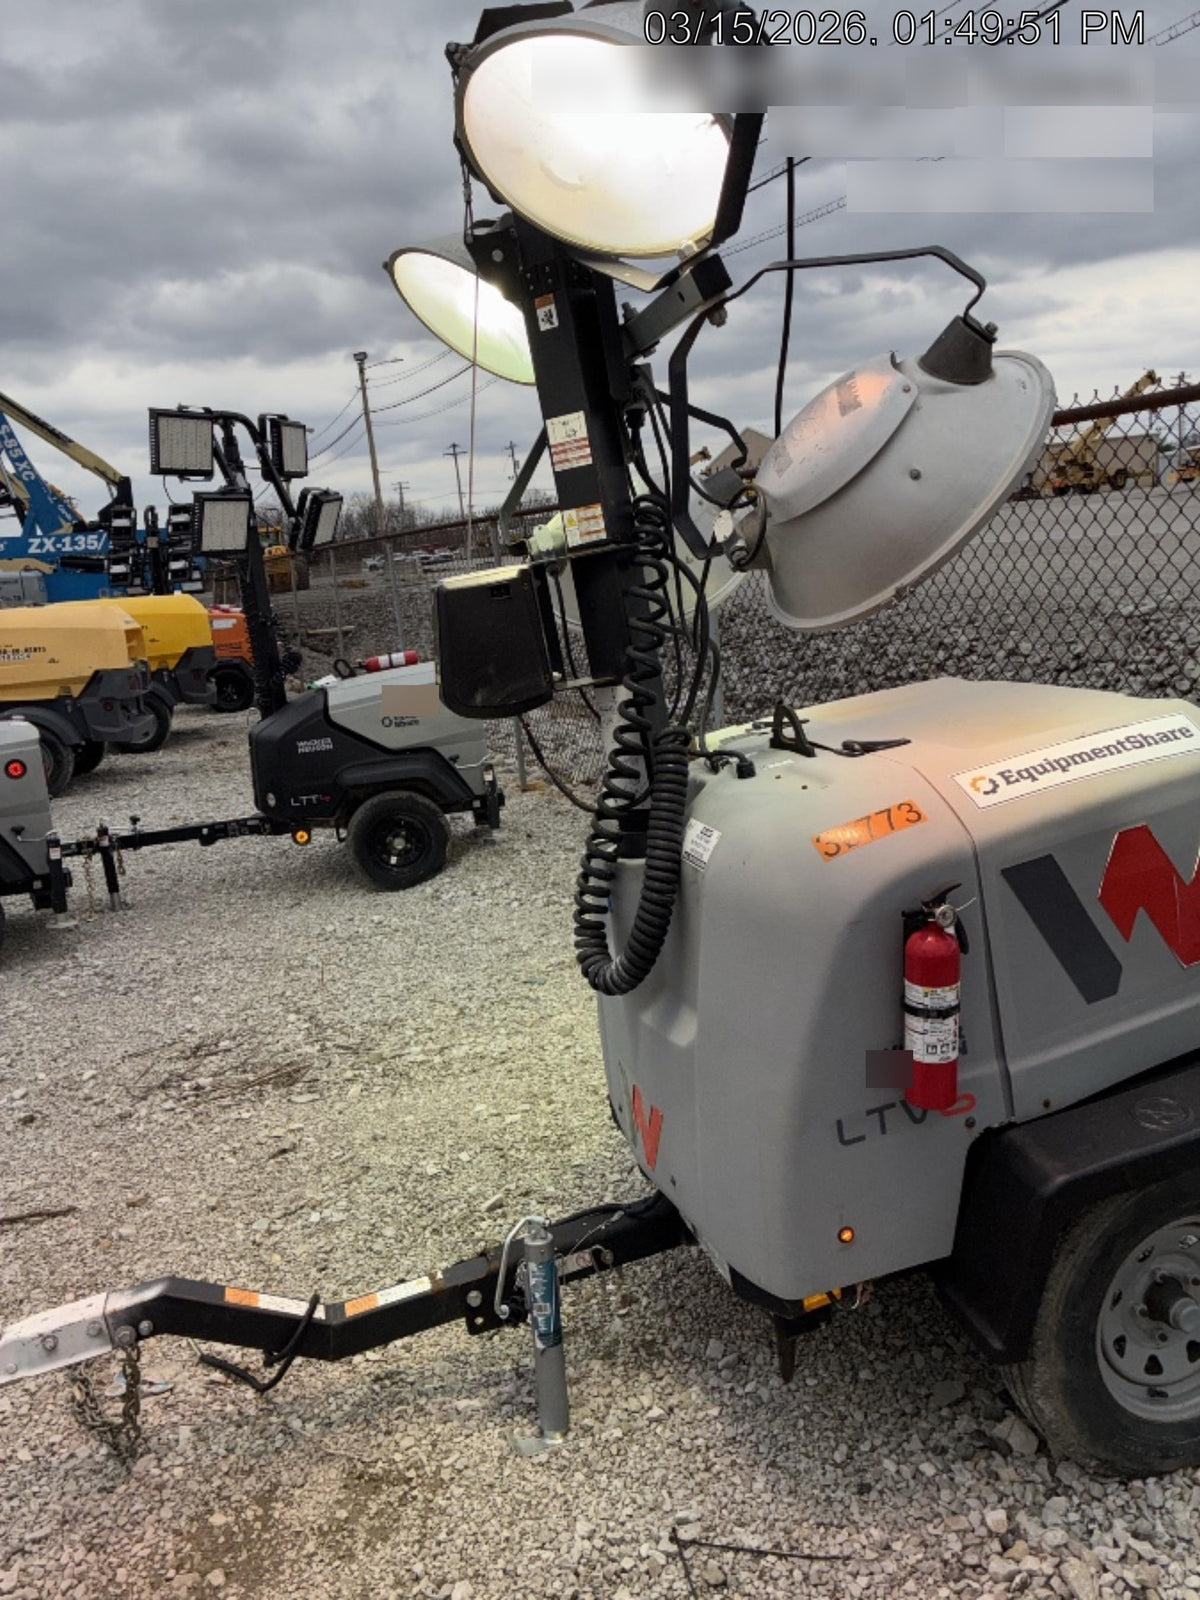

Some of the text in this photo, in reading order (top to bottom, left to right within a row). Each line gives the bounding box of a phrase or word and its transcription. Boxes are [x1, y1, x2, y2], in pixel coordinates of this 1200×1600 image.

[15, 459, 35, 481] XC
[28, 532, 113, 554] ZX-135/
[998, 724, 1195, 787] EquipmentShare
